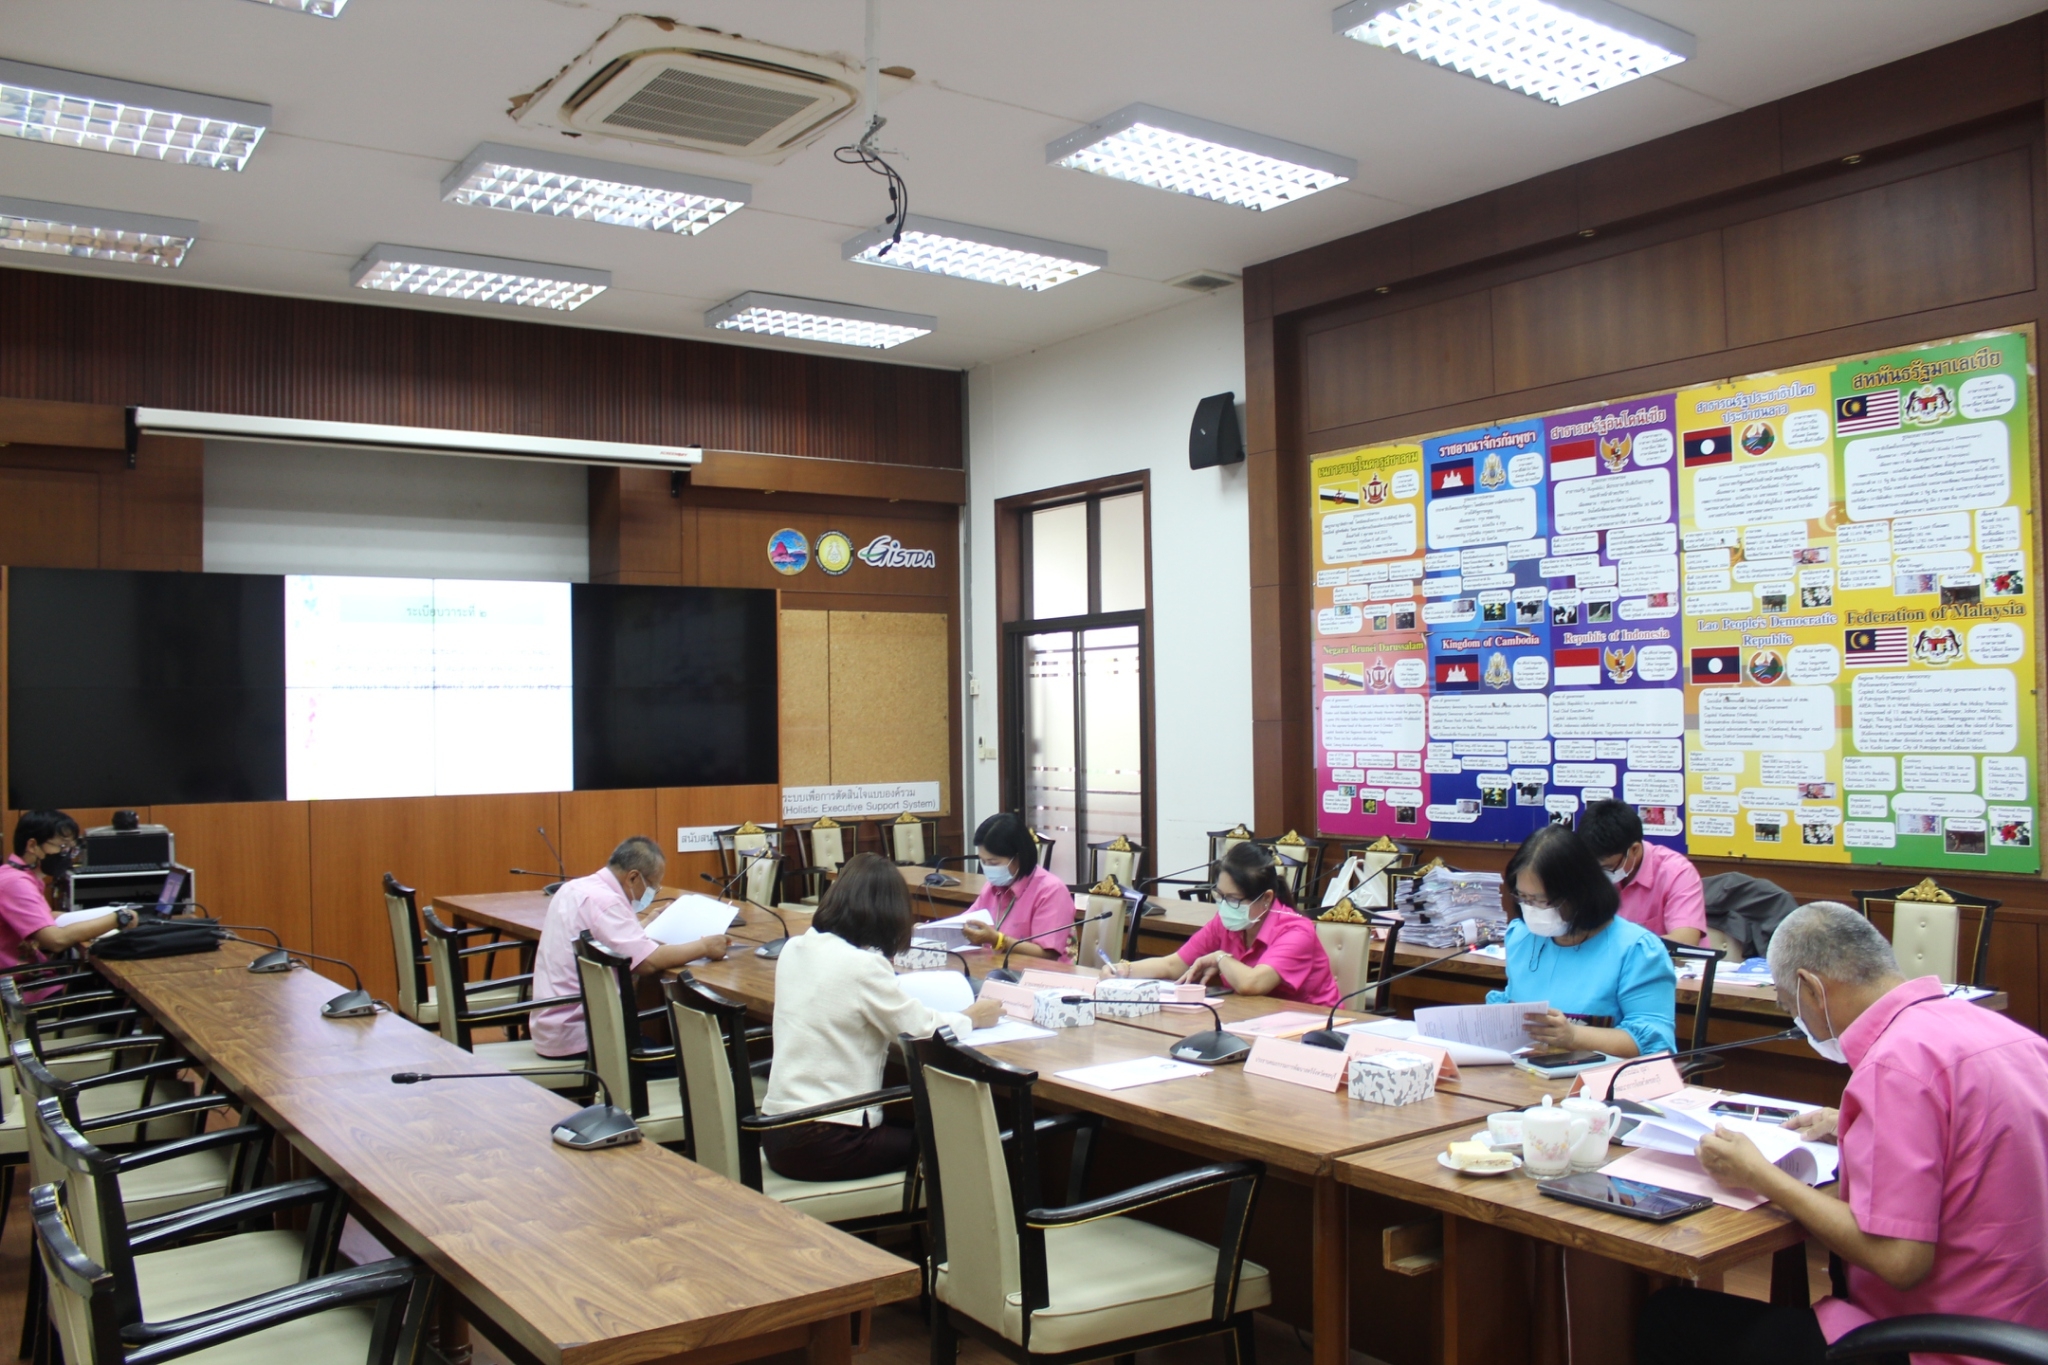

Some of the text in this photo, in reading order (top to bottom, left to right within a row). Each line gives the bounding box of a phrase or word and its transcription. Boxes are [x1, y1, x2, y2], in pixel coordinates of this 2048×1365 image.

[1697, 612, 1837, 632] Lao People's Democratic
[1846, 601, 2026, 625] Federation of Malaysia
[1442, 633, 1541, 651] Kingdom of Cambodia
[1563, 627, 1671, 646] Republic of Indonesia
[1742, 632, 1794, 648] Republic
[1323, 640, 1424, 656] Negara Brunei Darussalam
[783, 799, 936, 814] (Holistic Executive Support System)
